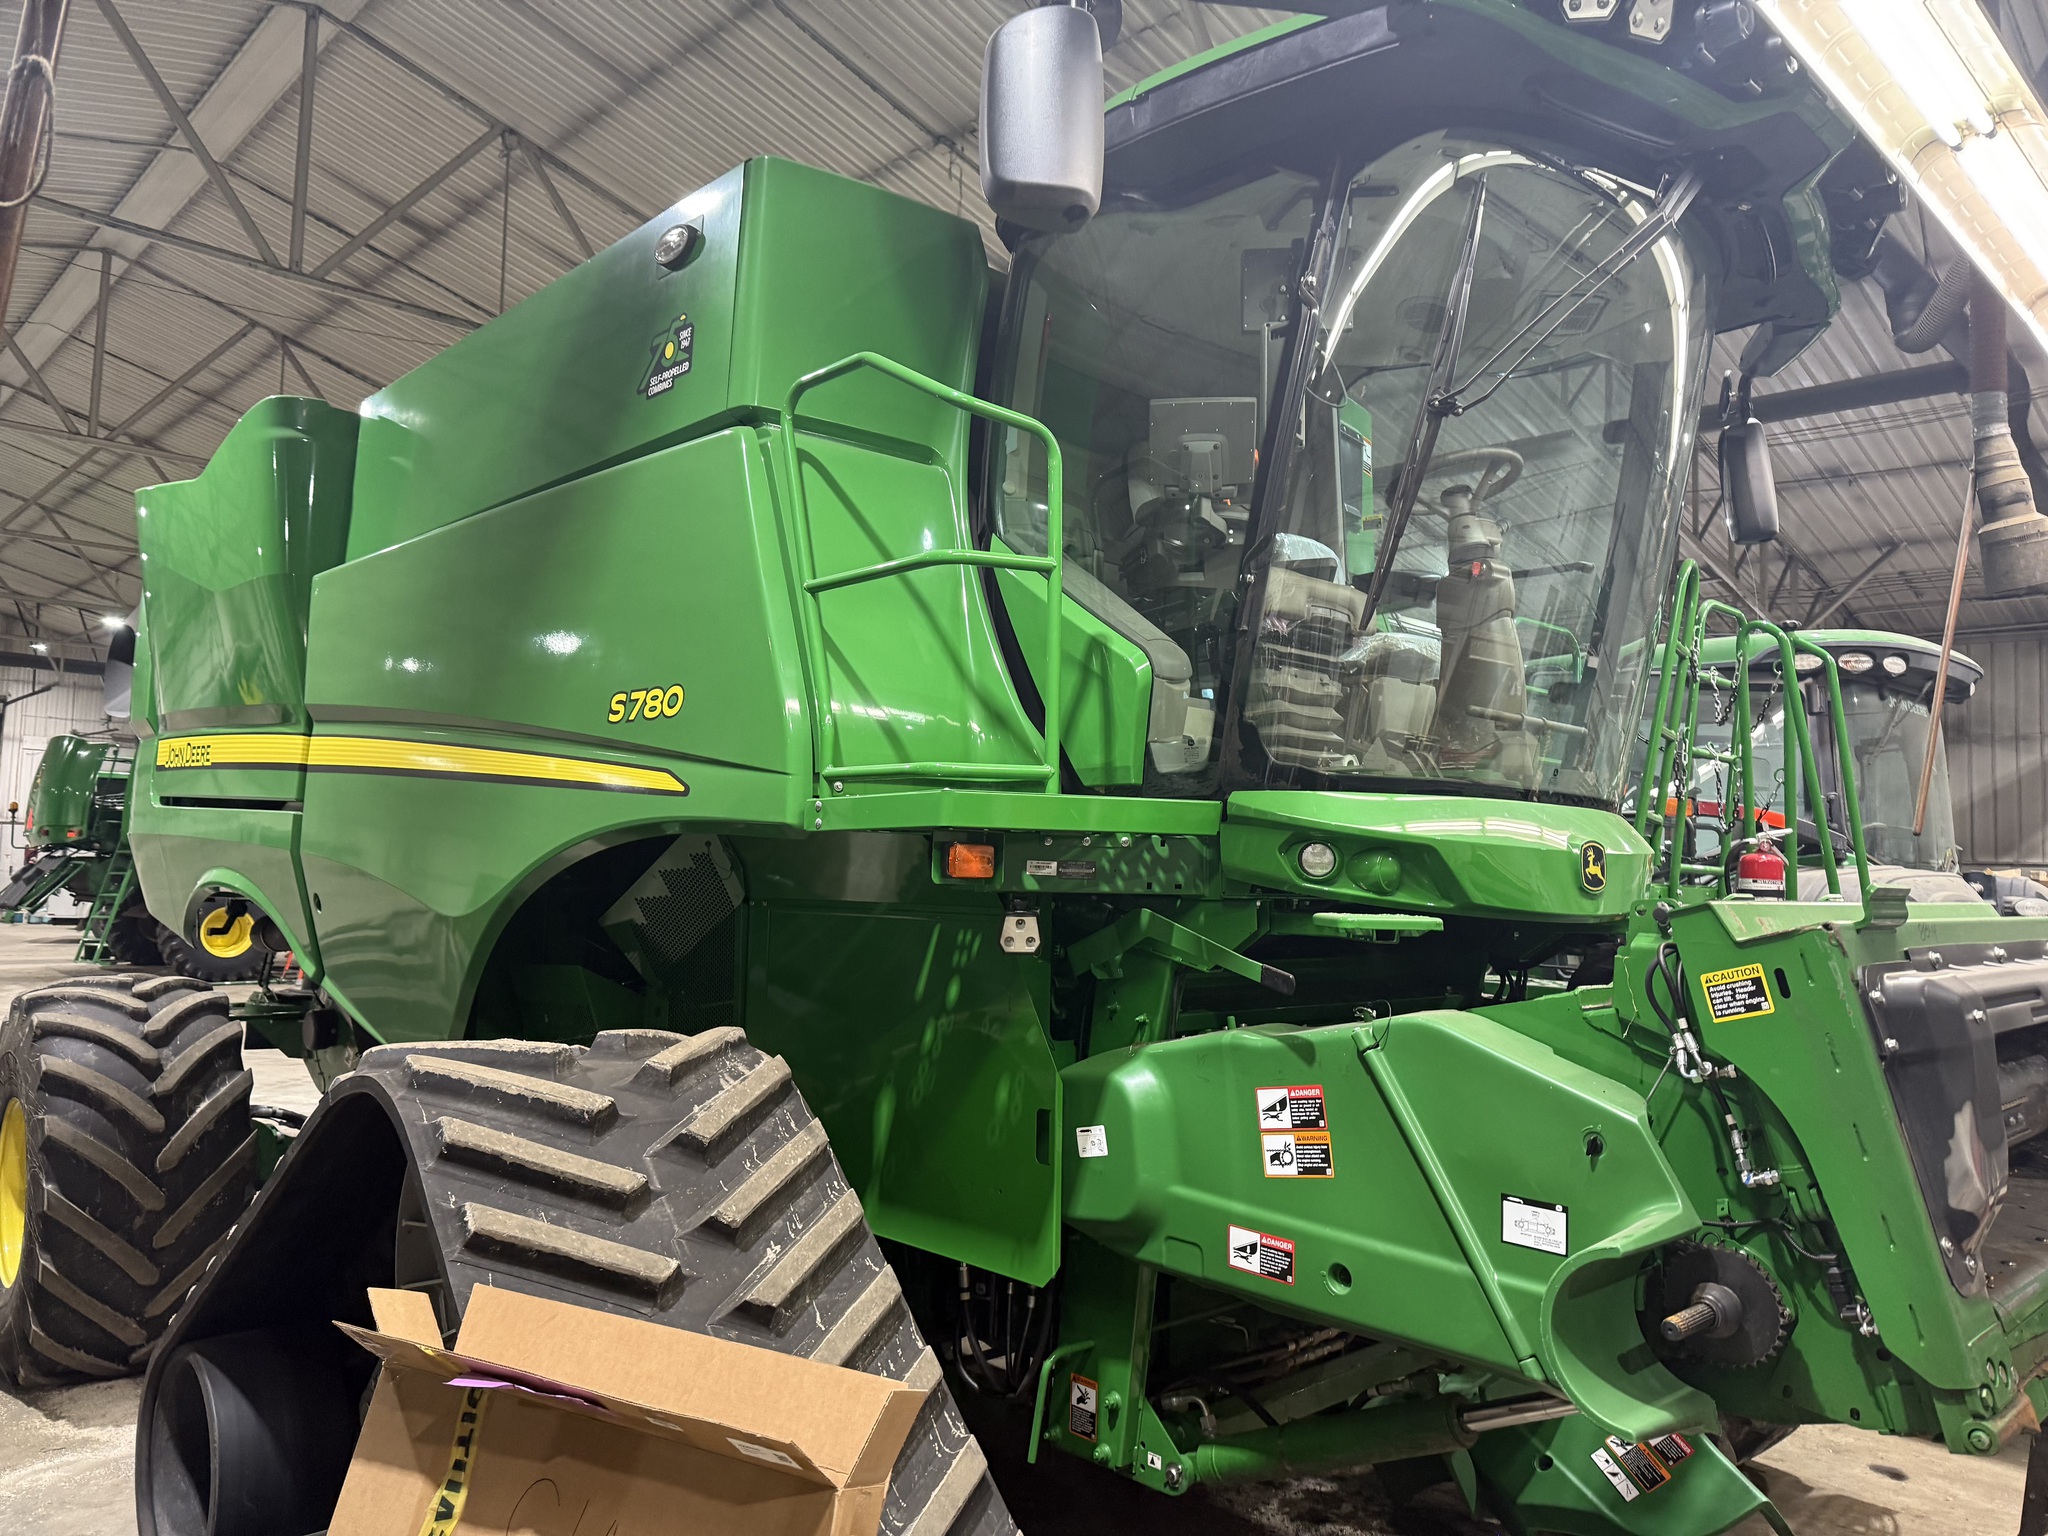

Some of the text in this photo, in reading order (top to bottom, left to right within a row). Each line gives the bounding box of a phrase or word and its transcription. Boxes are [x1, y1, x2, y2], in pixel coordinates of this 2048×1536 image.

[679, 327, 692, 340] SINCE
[680, 337, 691, 349] 1947
[649, 361, 690, 387] SELF-PROPELLED
[648, 377, 673, 396] COMBINES
[607, 683, 685, 724] S780
[165, 742, 212, 768] JOHN DEERE
[1712, 966, 1760, 982] CAUTION
[1709, 979, 1752, 993] Avoid crushing
[1710, 984, 1757, 999] injuries. Header
[1712, 997, 1723, 1005] can
[1735, 993, 1749, 1001] Stay
[1714, 1002, 1729, 1010] clear
[1729, 999, 1745, 1007] when
[1746, 996, 1766, 1006] engine
[1722, 1006, 1747, 1015] running.
[1295, 1088, 1321, 1097] DANGER
[1265, 1237, 1293, 1251] DANGER
